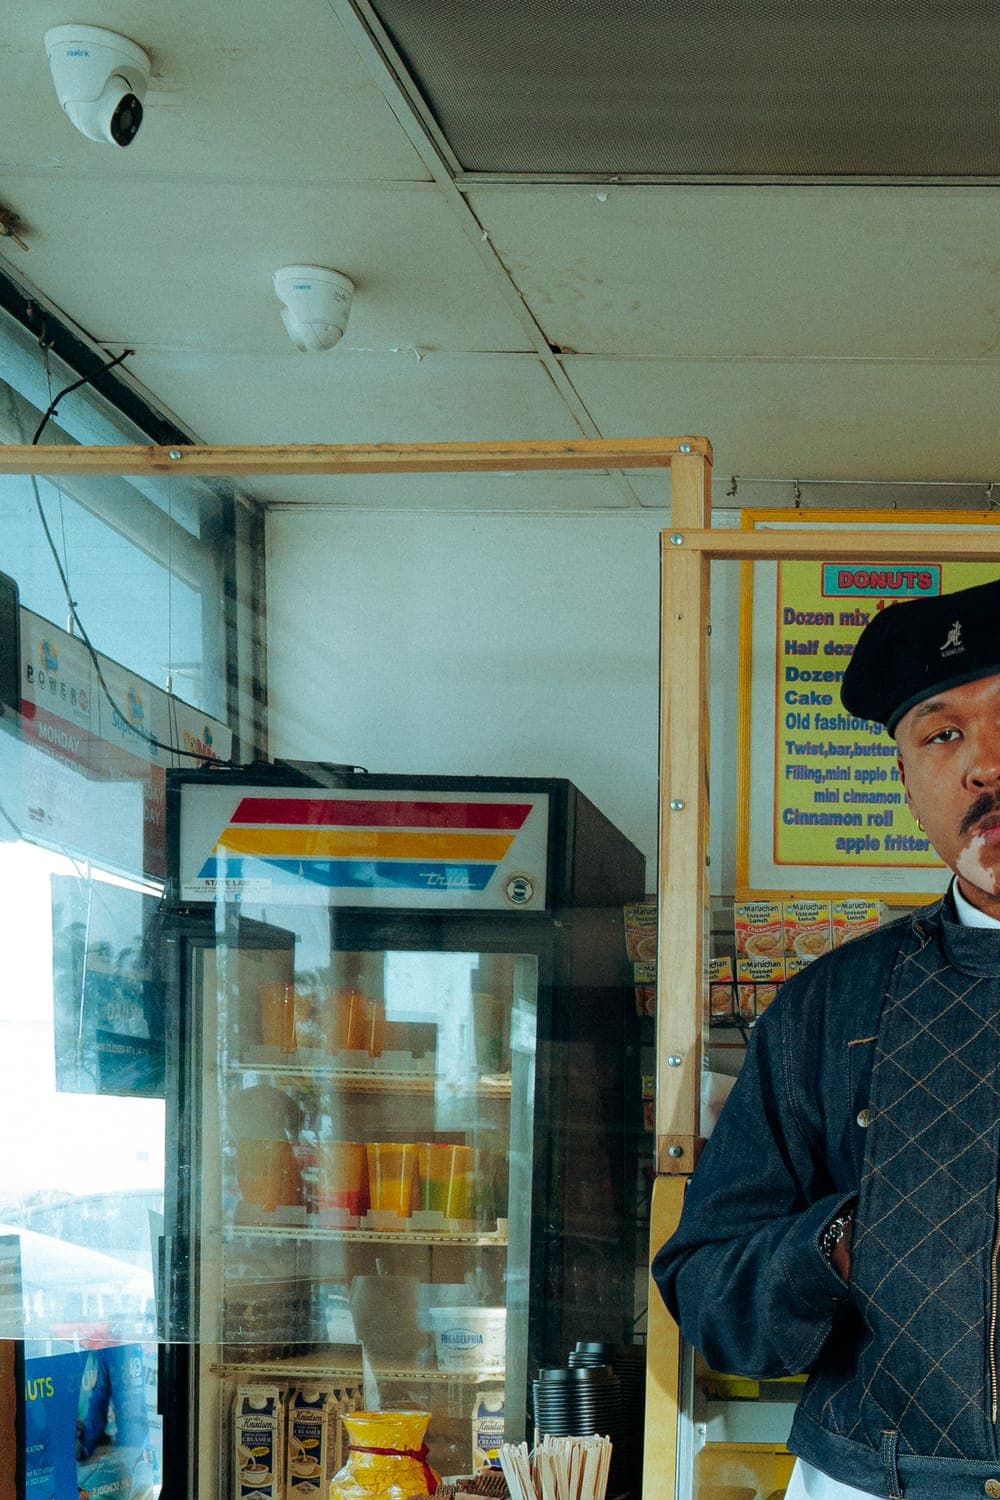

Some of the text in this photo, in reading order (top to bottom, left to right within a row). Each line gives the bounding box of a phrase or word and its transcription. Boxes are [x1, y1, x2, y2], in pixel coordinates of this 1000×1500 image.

[838, 570, 932, 589] DONUTS
[784, 607, 834, 626] Dozen
[785, 640, 856, 656] Half doz
[785, 690, 833, 706] Cake
[785, 712, 810, 731] Old
[814, 788, 839, 803] mini
[843, 788, 901, 804] cinnamon
[783, 808, 893, 826] Cinnamon roll
[836, 834, 930, 854] apple fritter
[441, 1333, 484, 1345] PHILADELPHIA
[25, 1376, 55, 1401] UTS
[242, 1417, 272, 1429] Knudsen
[294, 1410, 322, 1421] Knudsen
